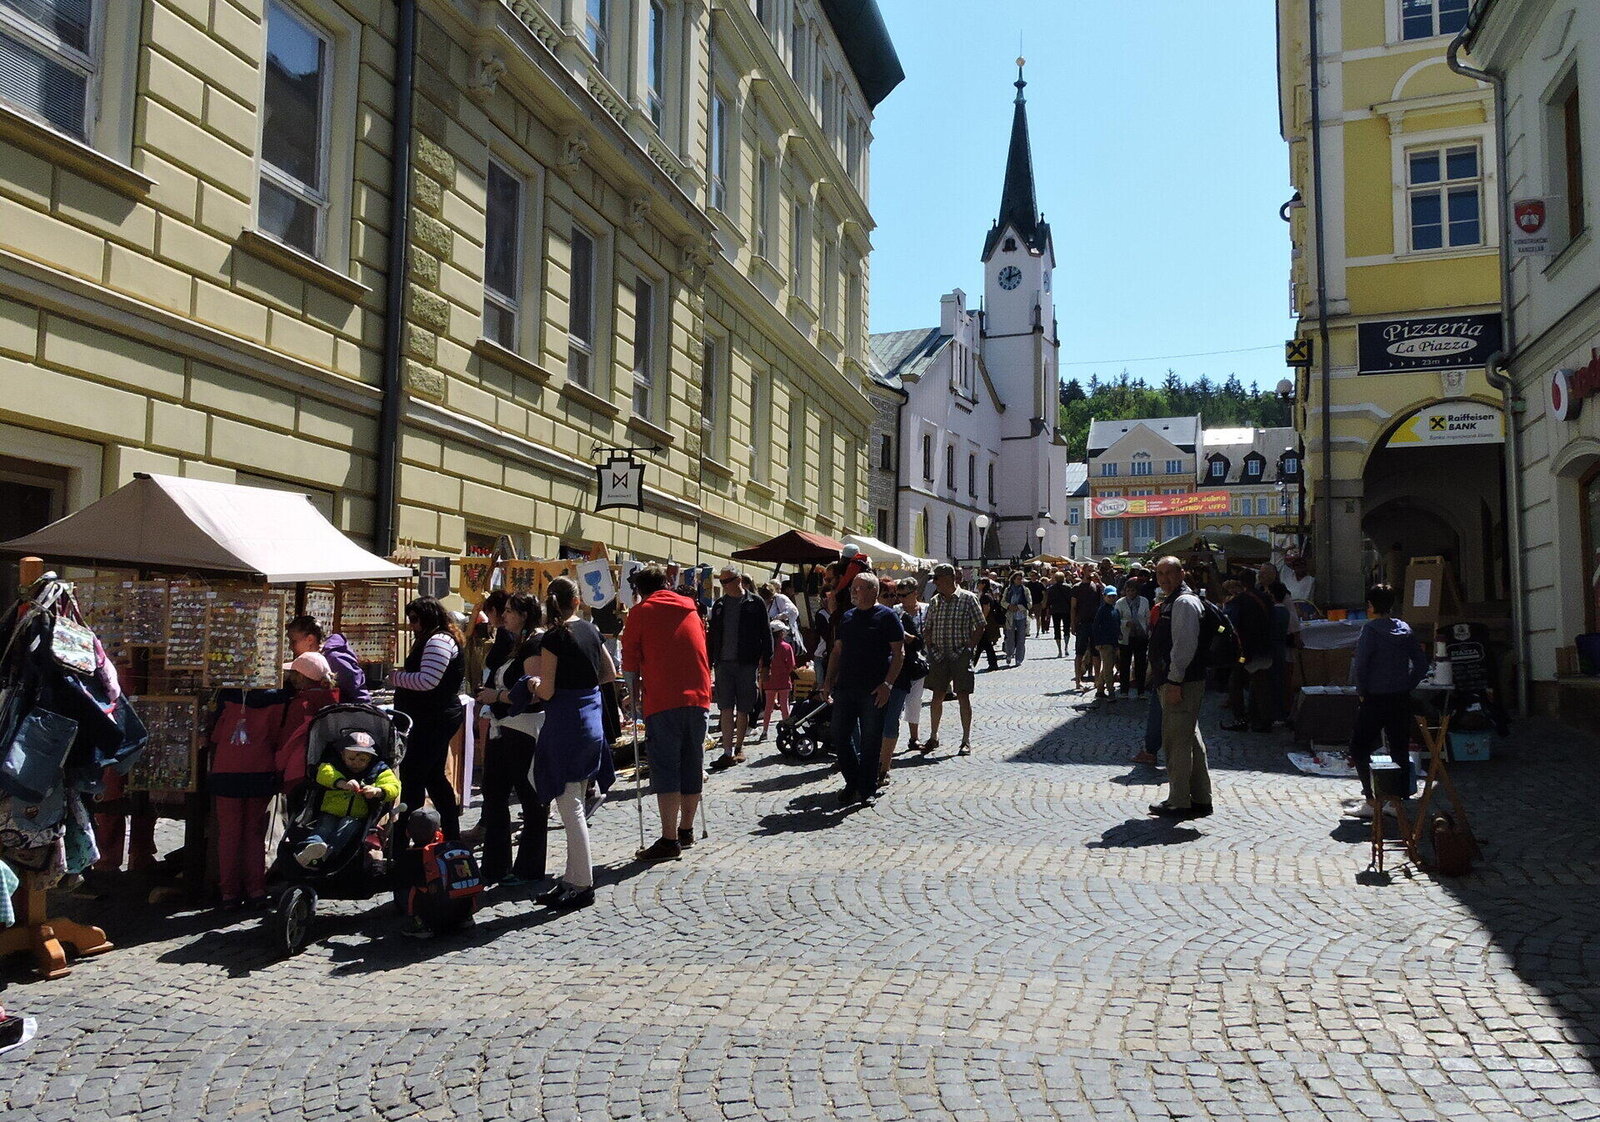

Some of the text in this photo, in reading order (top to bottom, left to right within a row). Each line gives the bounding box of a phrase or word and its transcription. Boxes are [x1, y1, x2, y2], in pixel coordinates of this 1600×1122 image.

[1383, 319, 1485, 342] Pizzeria
[1395, 340, 1470, 354] La Piazza
[1448, 413, 1495, 422] Raiffeisen
[1448, 422, 1477, 431] BANK
